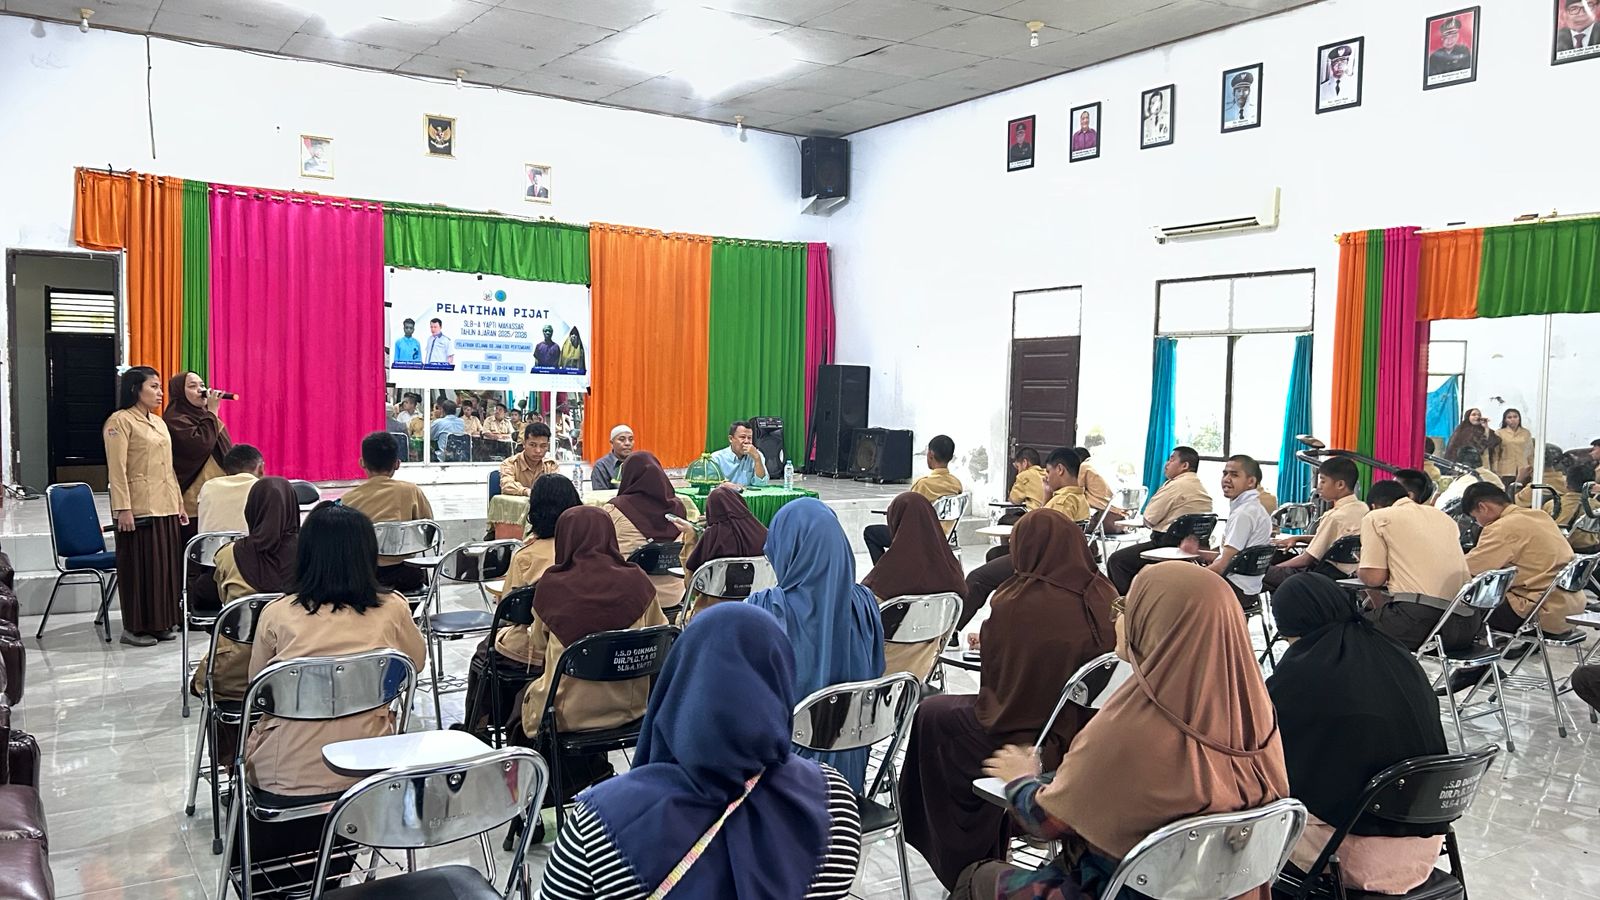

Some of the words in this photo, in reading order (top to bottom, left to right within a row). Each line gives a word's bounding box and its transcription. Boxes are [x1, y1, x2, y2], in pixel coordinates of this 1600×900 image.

[436, 303, 506, 317] PELATIHAN
[513, 307, 550, 319] PIJAT
[463, 319, 481, 328] SLB-A
[498, 322, 525, 330] MAKASSAR
[461, 327, 476, 336] TAHUN
[477, 329, 497, 337] AJARAN
